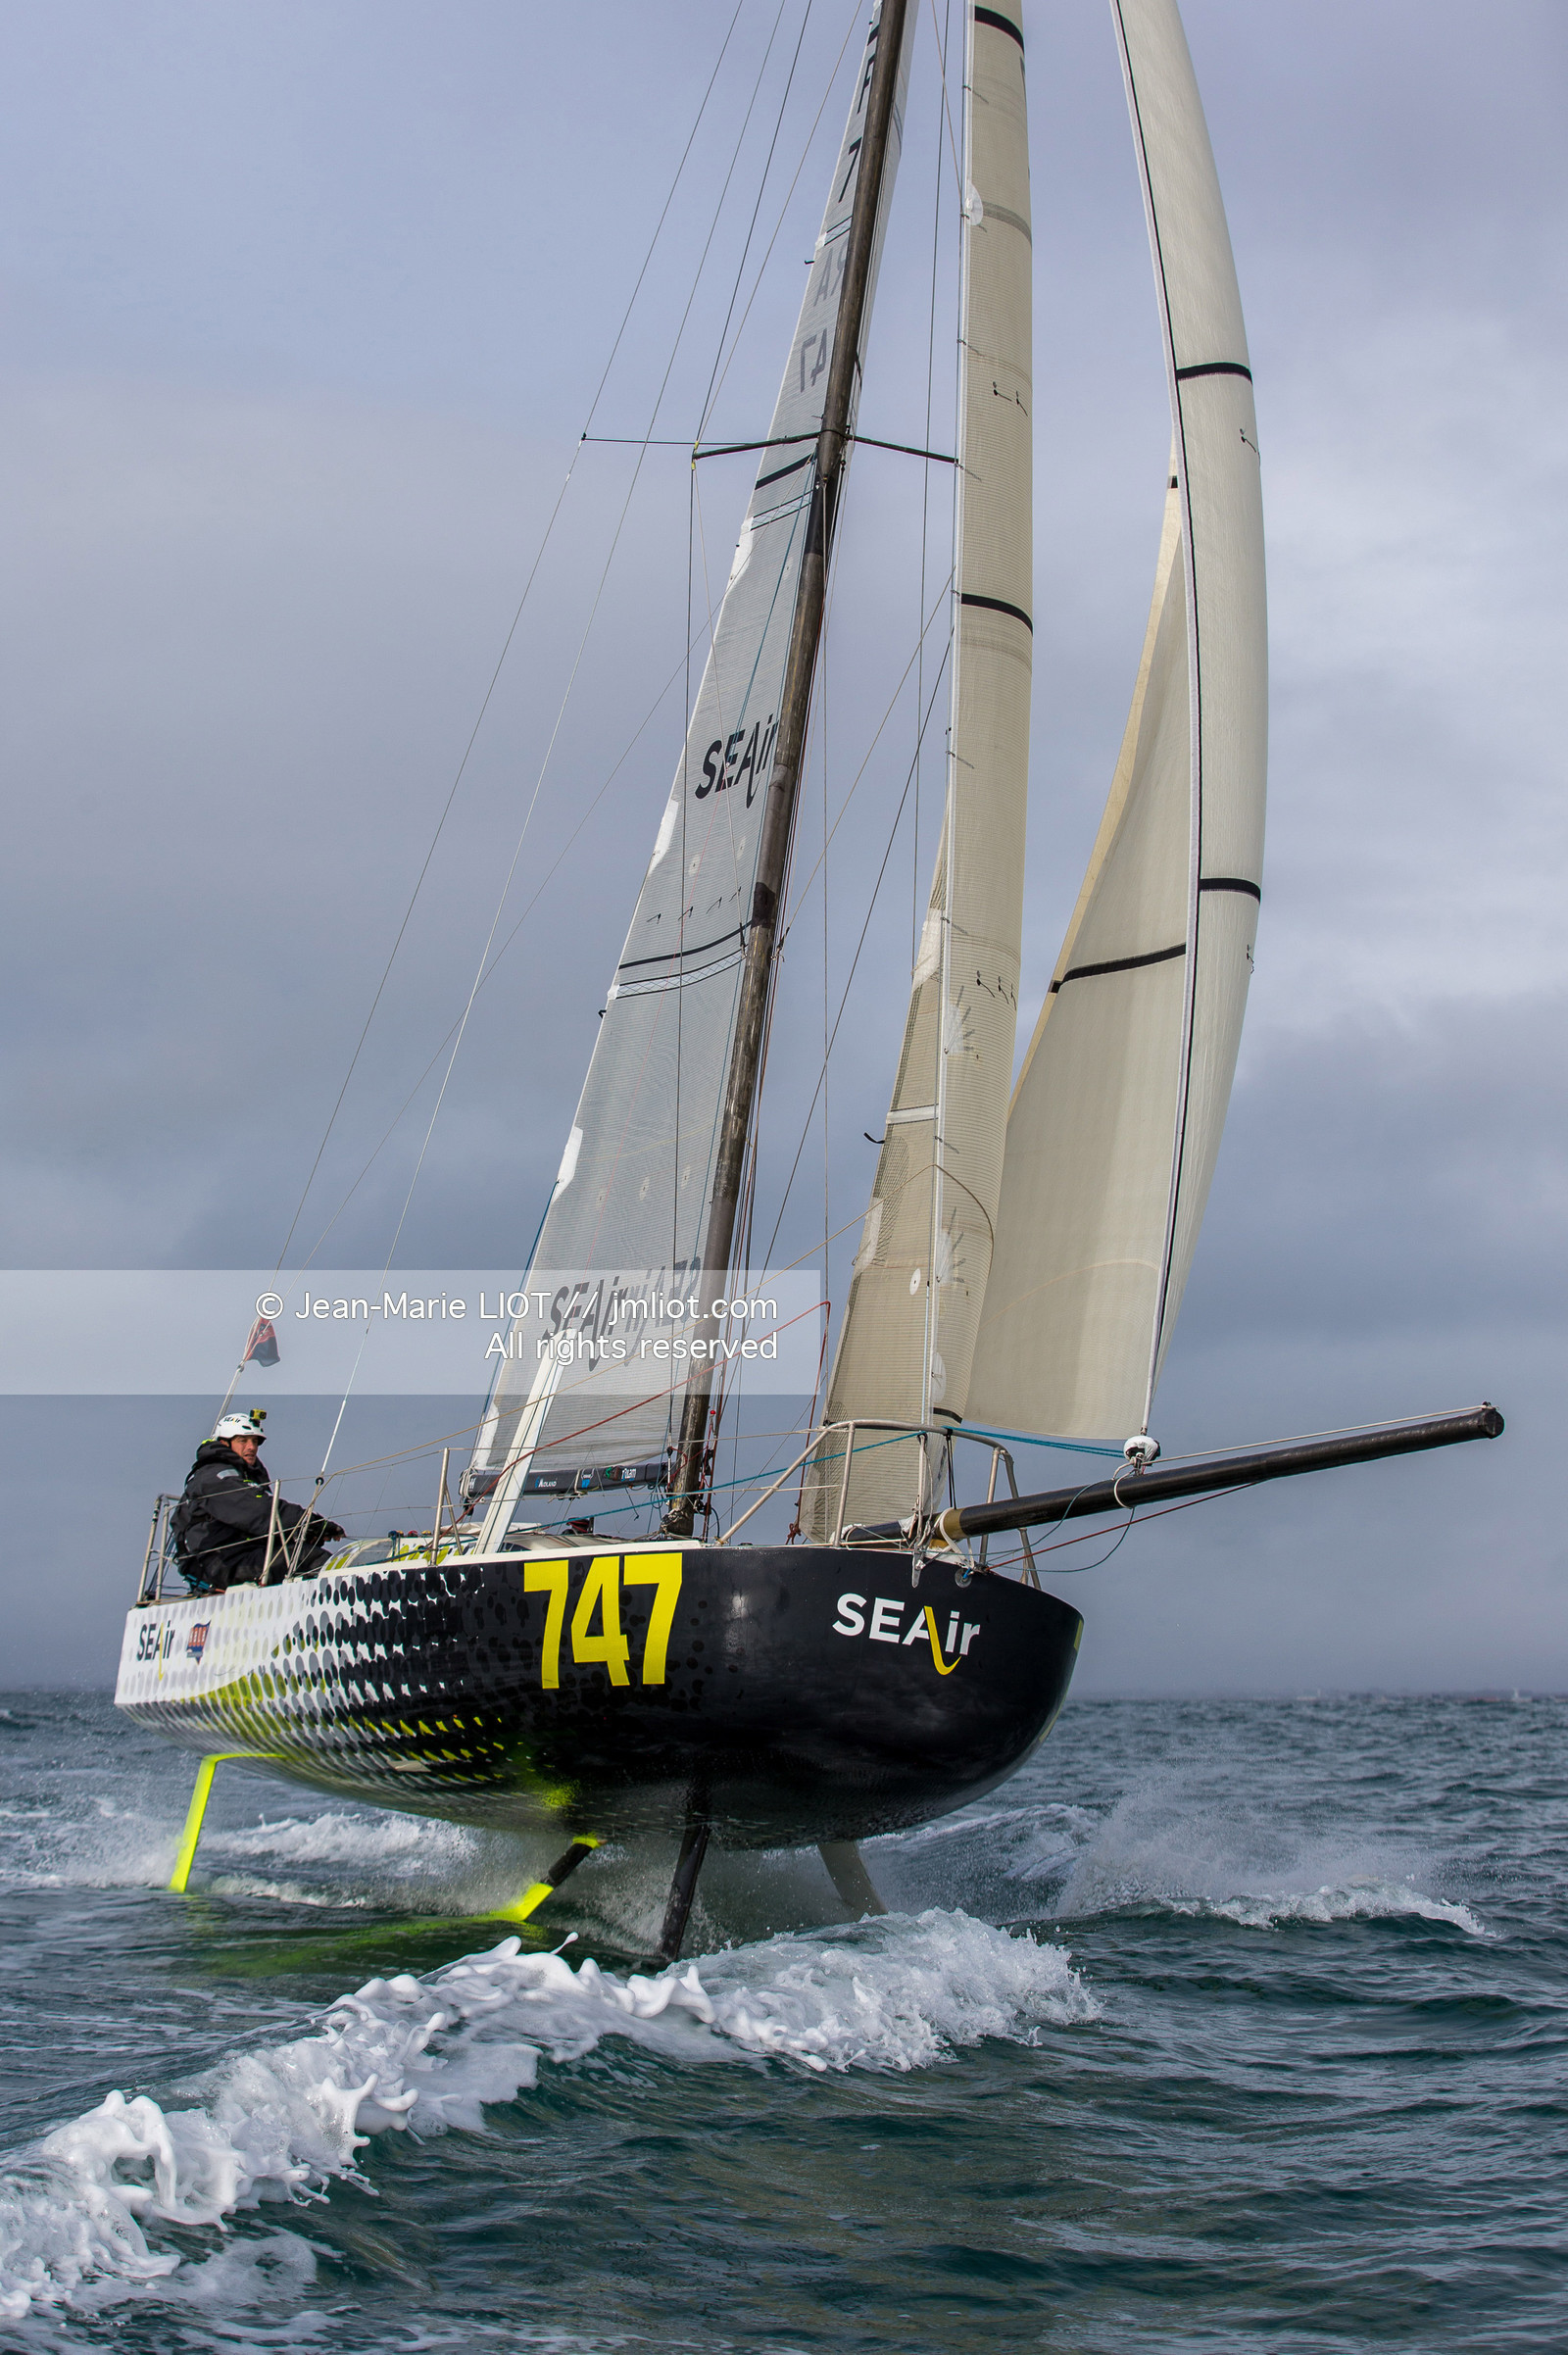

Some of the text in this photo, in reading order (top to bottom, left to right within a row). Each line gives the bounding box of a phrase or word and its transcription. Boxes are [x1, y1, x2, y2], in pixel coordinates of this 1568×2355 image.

[695, 713, 779, 810] SEAir
[136, 1620, 176, 1682] SEAir
[523, 1552, 683, 1690] 747
[832, 1593, 981, 1676] SEAir
